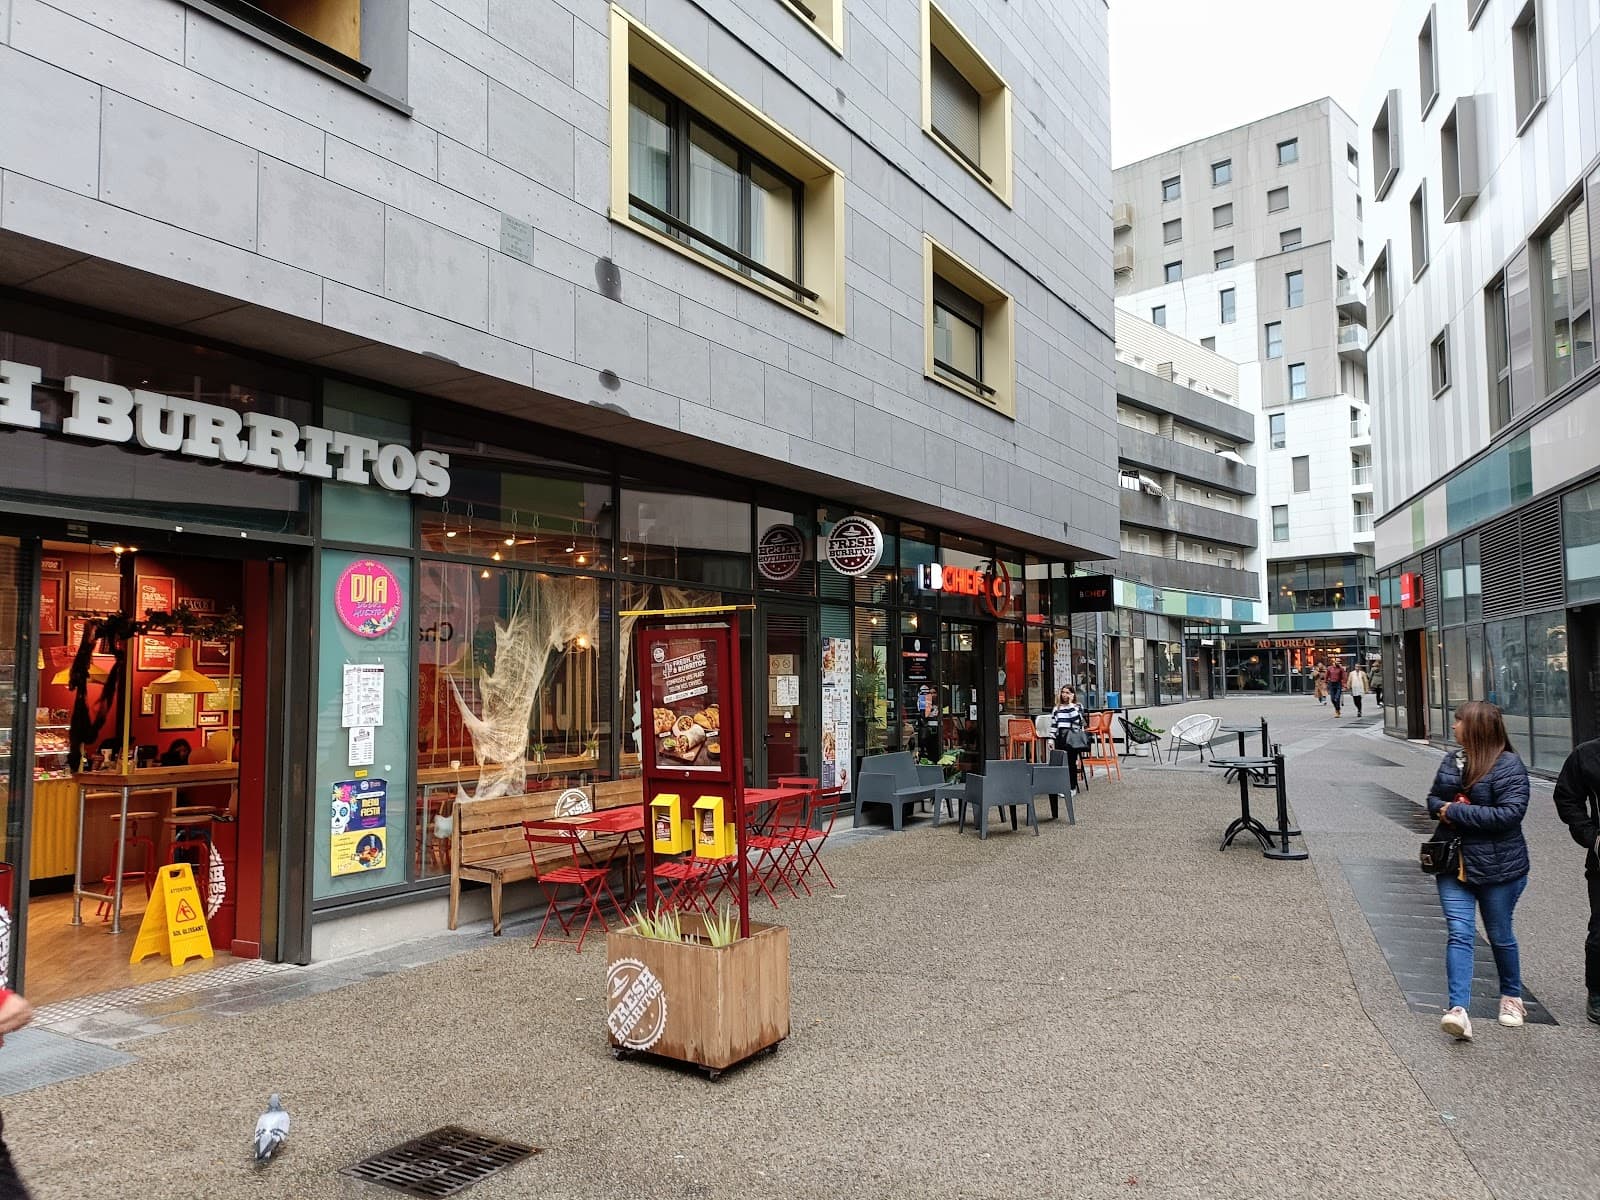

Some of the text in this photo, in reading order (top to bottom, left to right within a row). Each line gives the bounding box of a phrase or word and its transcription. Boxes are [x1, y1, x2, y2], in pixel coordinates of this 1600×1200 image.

[63, 376, 450, 497] BURRITOS
[829, 537, 876, 550] FRESH
[829, 547, 877, 557] BURRITOS
[351, 574, 388, 603] DIA
[1257, 638, 1316, 648] AU BUREAU
[678, 660, 706, 672] BURRITOS
[607, 966, 656, 1035] FRESH
[614, 978, 663, 1046] BURRITOS
